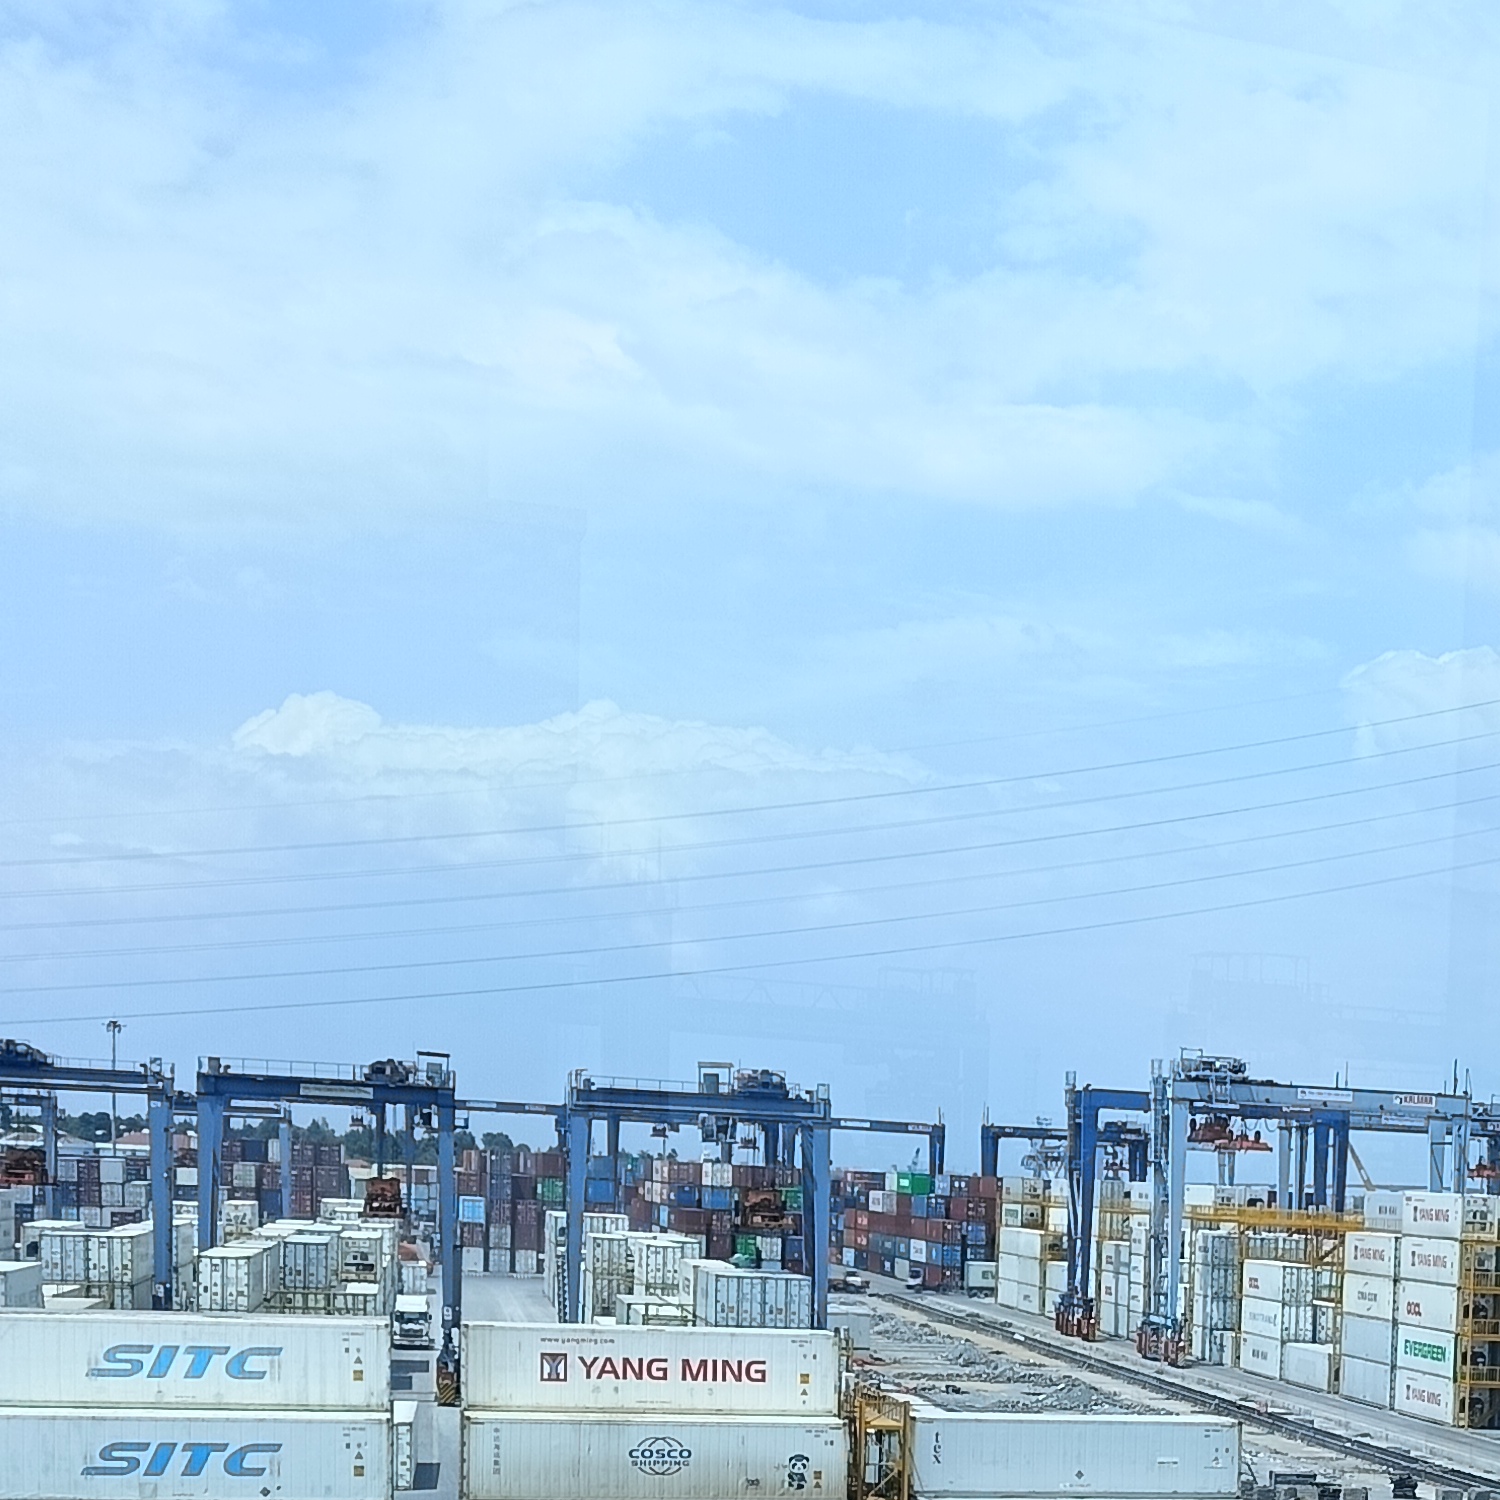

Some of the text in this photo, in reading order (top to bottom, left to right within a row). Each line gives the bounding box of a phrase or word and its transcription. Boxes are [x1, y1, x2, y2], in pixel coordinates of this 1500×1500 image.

[85, 1344, 283, 1379] SITC
[1404, 1339, 1446, 1363] EVERGREEN
[578, 1356, 767, 1383] YANG MING
[80, 1442, 283, 1477] SITC
[628, 1448, 692, 1460] COSCO
